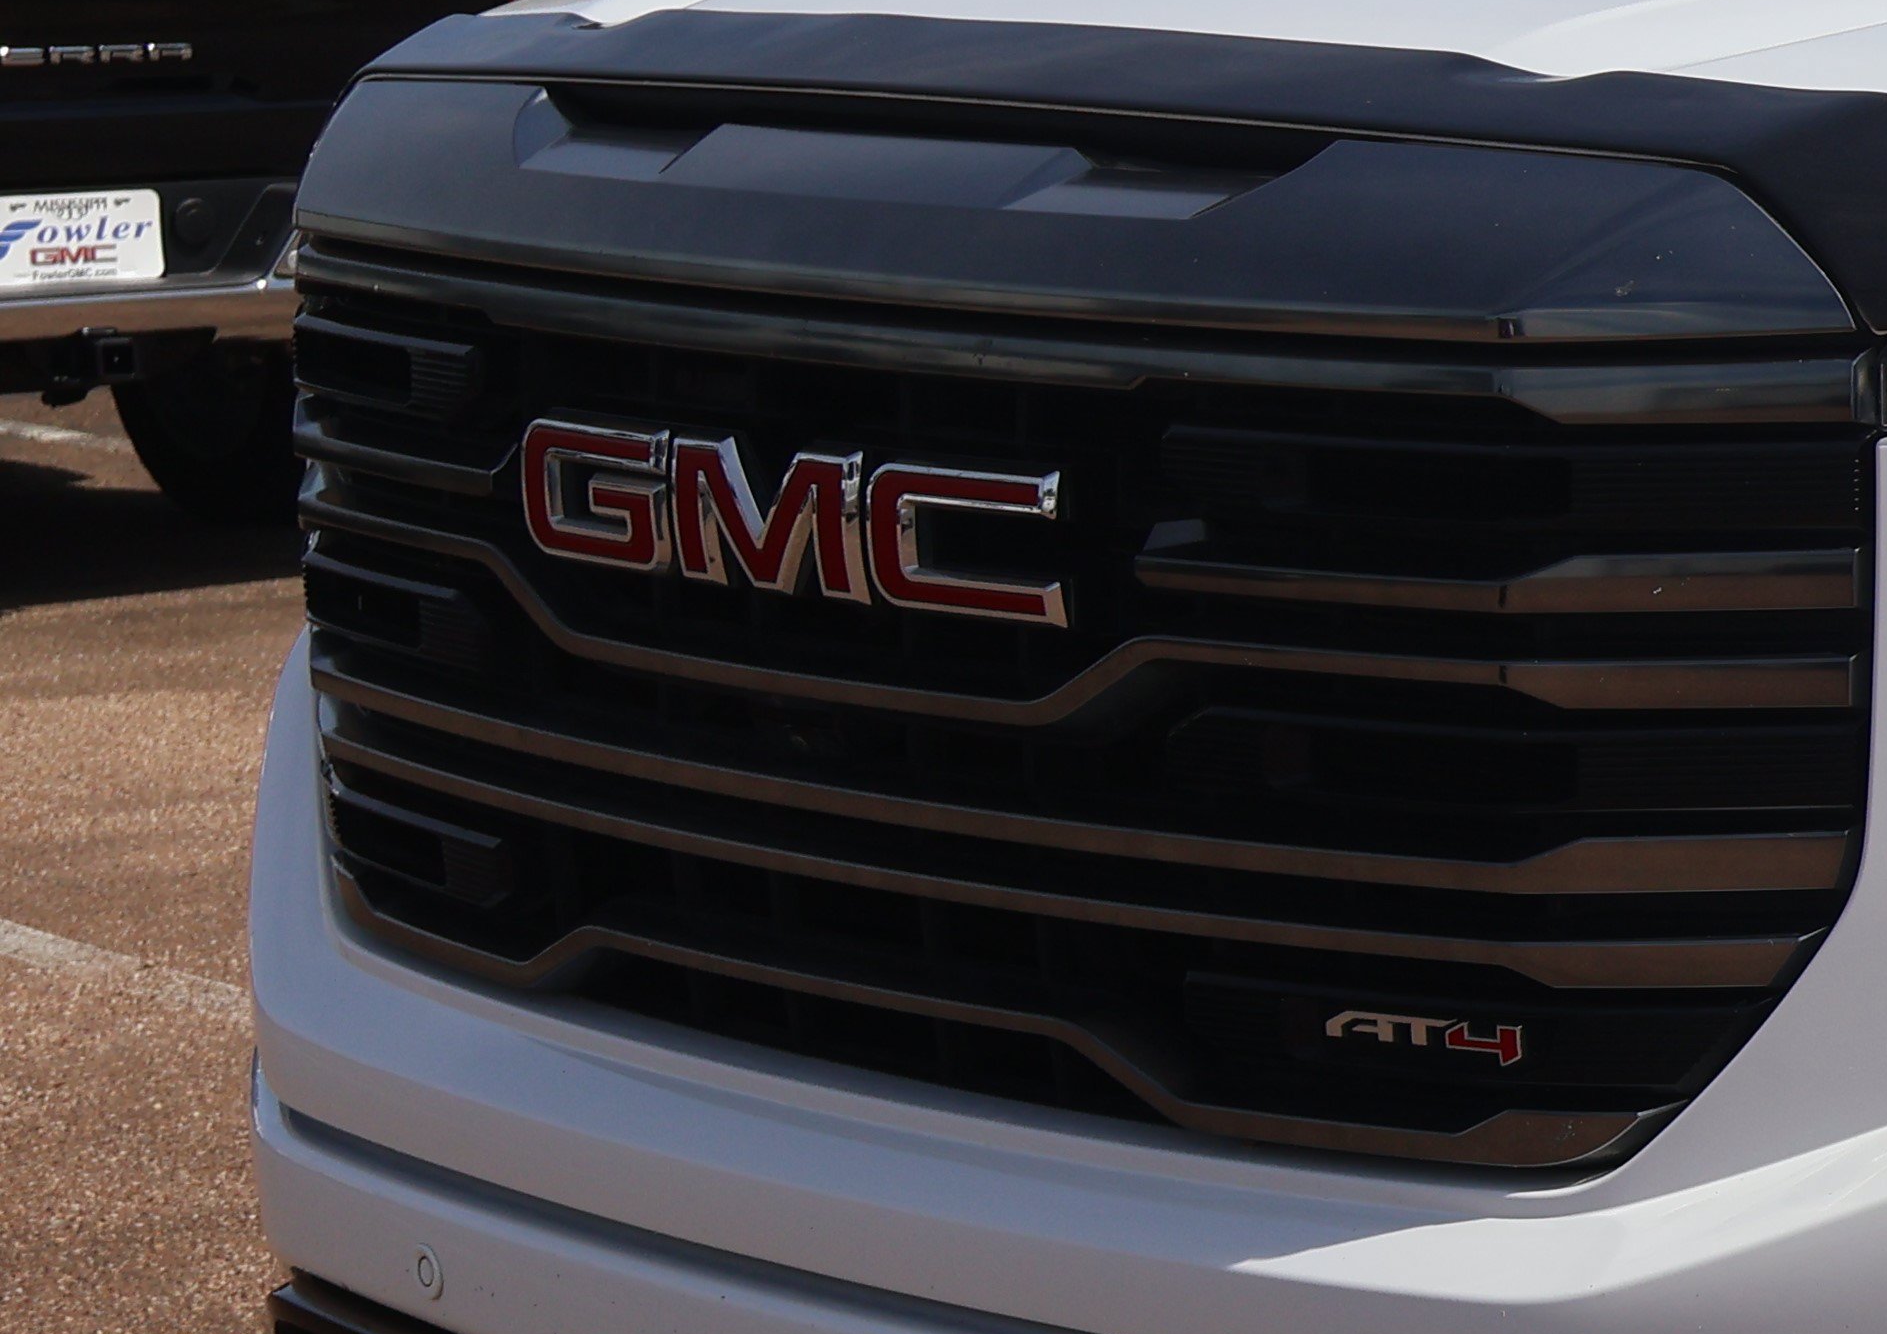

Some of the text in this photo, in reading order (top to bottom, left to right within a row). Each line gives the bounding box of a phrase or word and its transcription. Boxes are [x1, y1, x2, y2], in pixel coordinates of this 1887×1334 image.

[30, 243, 117, 266] GMC
[521, 417, 1068, 628] GMC
[1326, 1010, 1523, 1067] AT4
